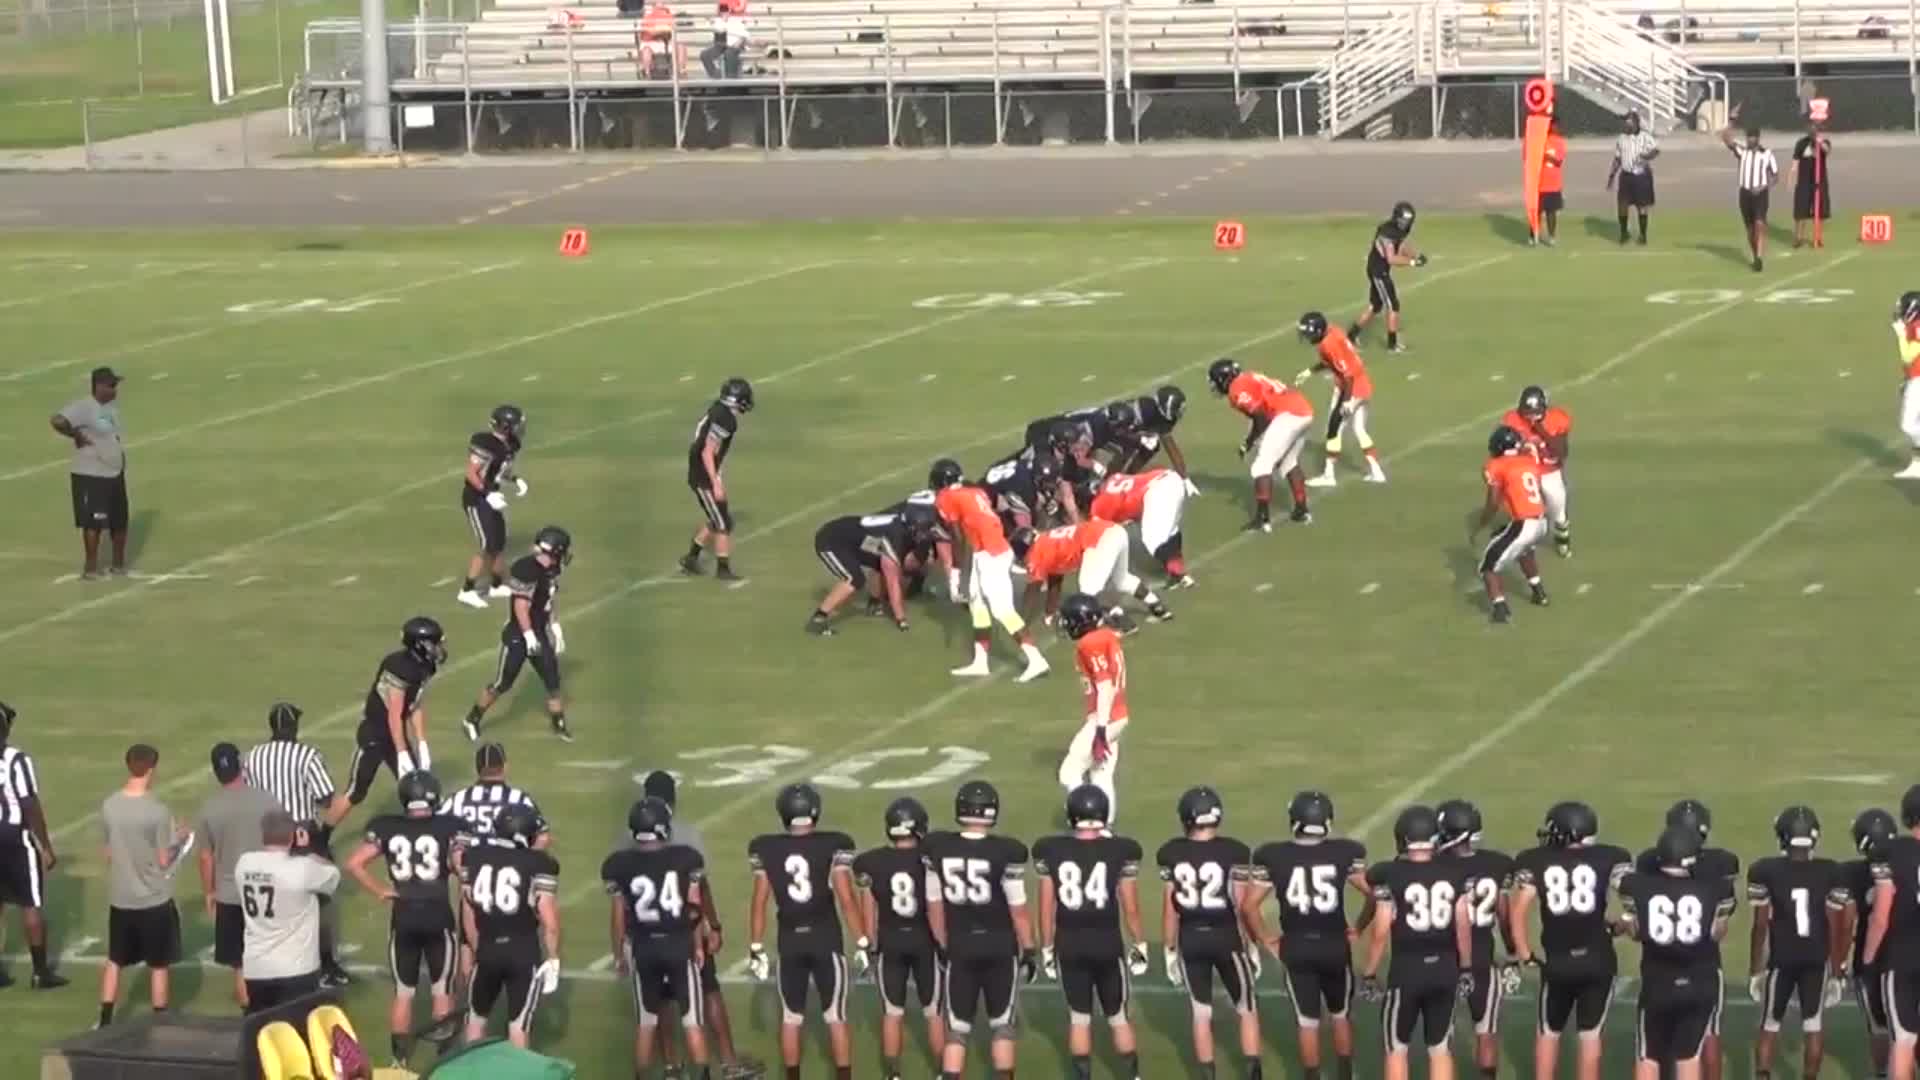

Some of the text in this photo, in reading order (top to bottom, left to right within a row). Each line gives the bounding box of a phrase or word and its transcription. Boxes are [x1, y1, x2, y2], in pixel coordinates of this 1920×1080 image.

[564, 233, 582, 250] 10
[1217, 226, 1237, 245] 20
[1521, 472, 1542, 505] 9
[677, 744, 991, 789] 30
[386, 834, 441, 882] 33
[784, 854, 812, 903] 3
[941, 857, 991, 903] 55
[243, 884, 275, 919] 67
[473, 863, 521, 914] 46
[629, 869, 683, 921] 24
[890, 871, 916, 916] 8
[1058, 860, 1109, 910] 84
[1173, 861, 1226, 909] 32
[1286, 864, 1338, 914] 45
[1404, 880, 1455, 931] 36
[1467, 877, 1498, 927] 2
[1543, 864, 1598, 916] 88
[1647, 894, 1703, 945] 68
[1791, 887, 1811, 937] 1
